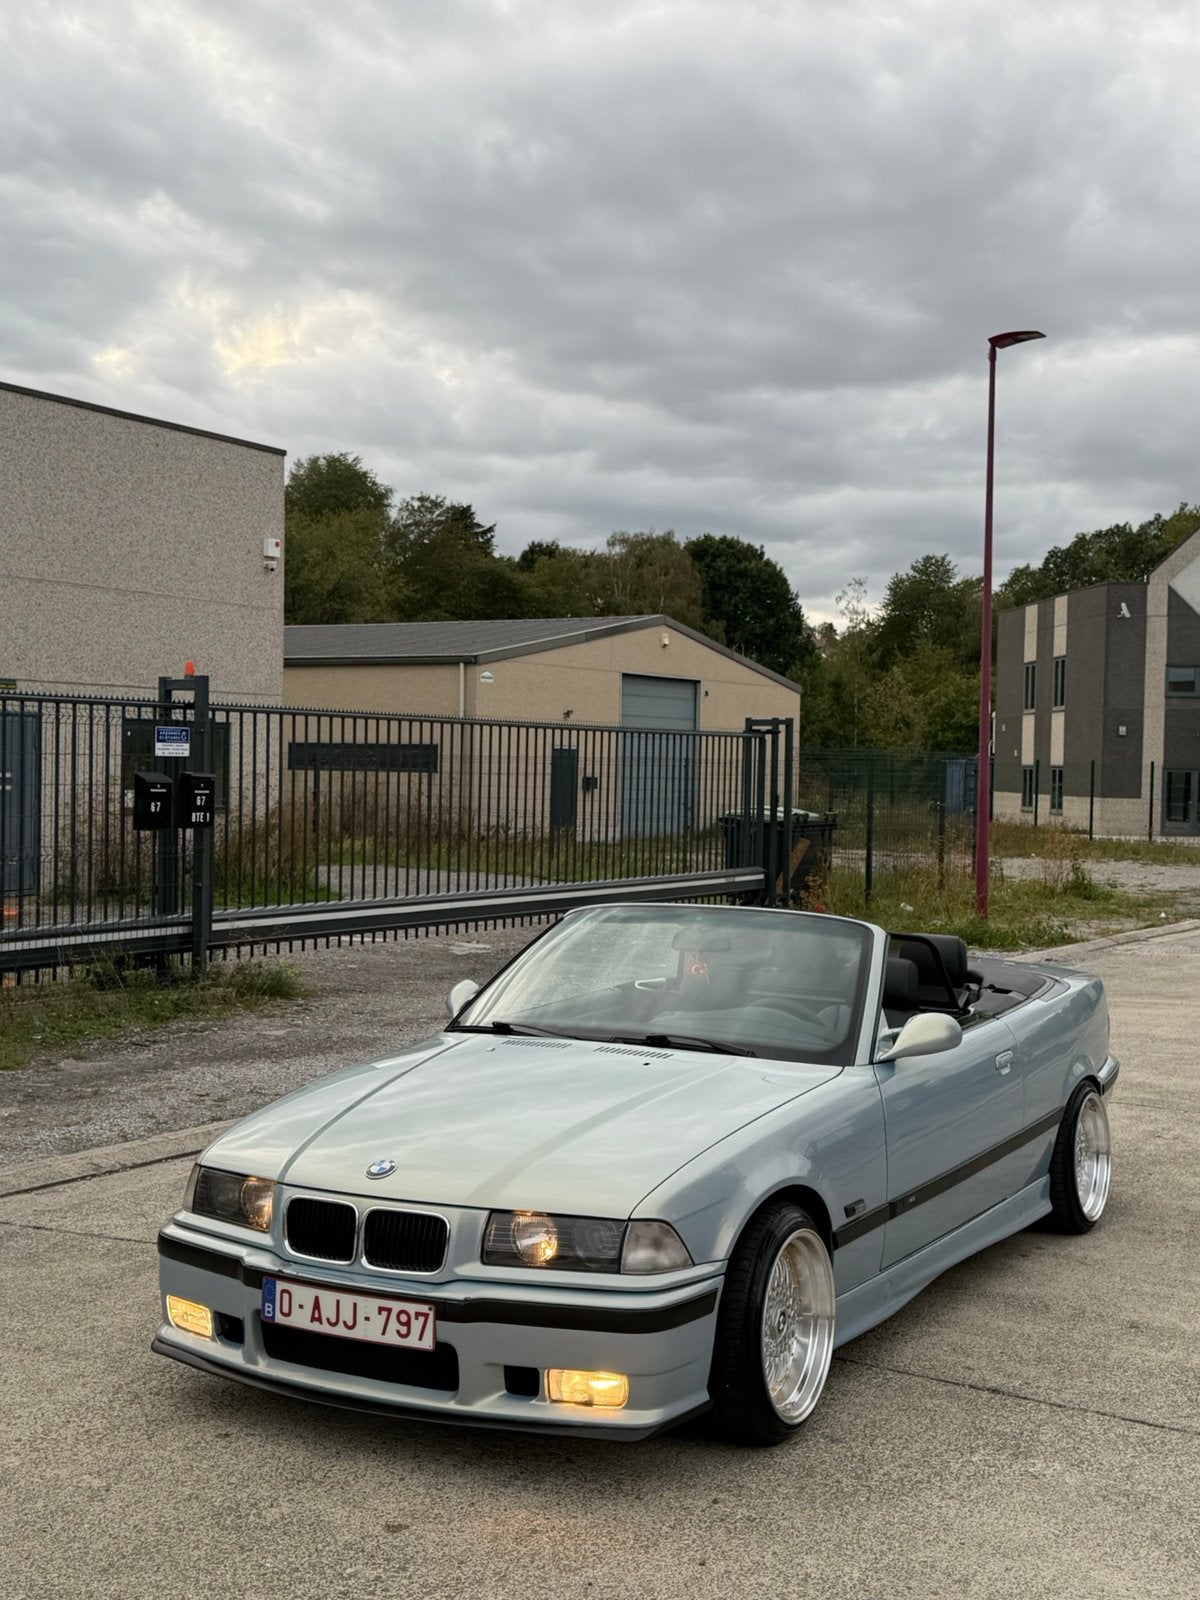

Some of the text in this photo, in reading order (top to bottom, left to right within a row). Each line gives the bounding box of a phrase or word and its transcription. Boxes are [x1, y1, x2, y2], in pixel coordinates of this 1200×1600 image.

[196, 796, 206, 806] 67
[150, 802, 161, 812] 67
[191, 812, 204, 822] BTE
[264, 1302, 274, 1317] B
